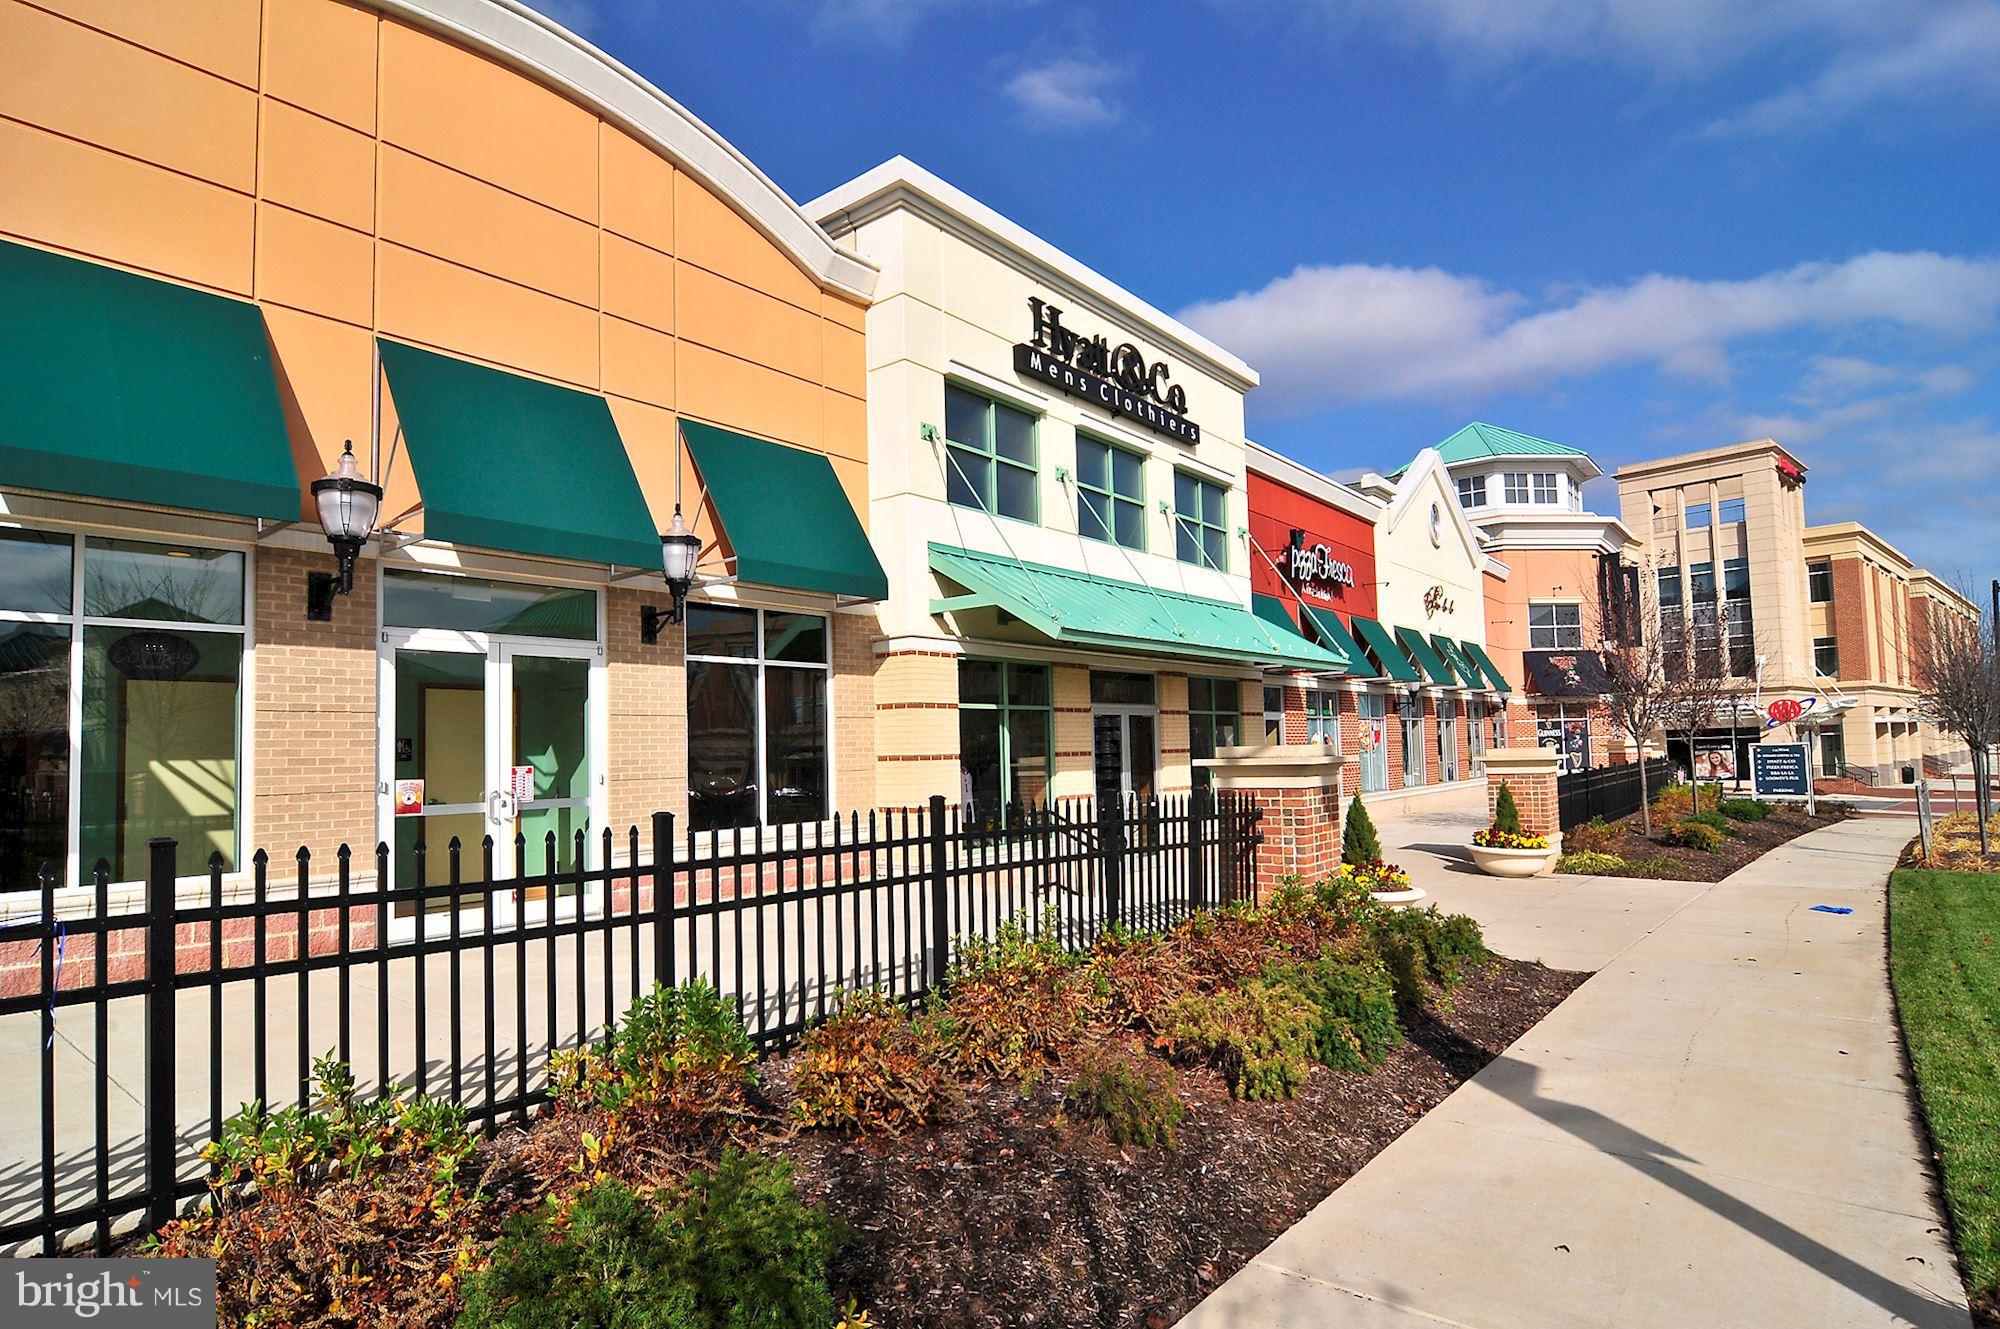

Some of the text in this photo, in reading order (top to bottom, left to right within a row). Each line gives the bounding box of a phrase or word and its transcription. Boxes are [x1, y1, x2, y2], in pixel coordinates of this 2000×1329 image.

[1030, 351, 1197, 440] Mens Clothiers
[114, 645, 193, 668] Coee
